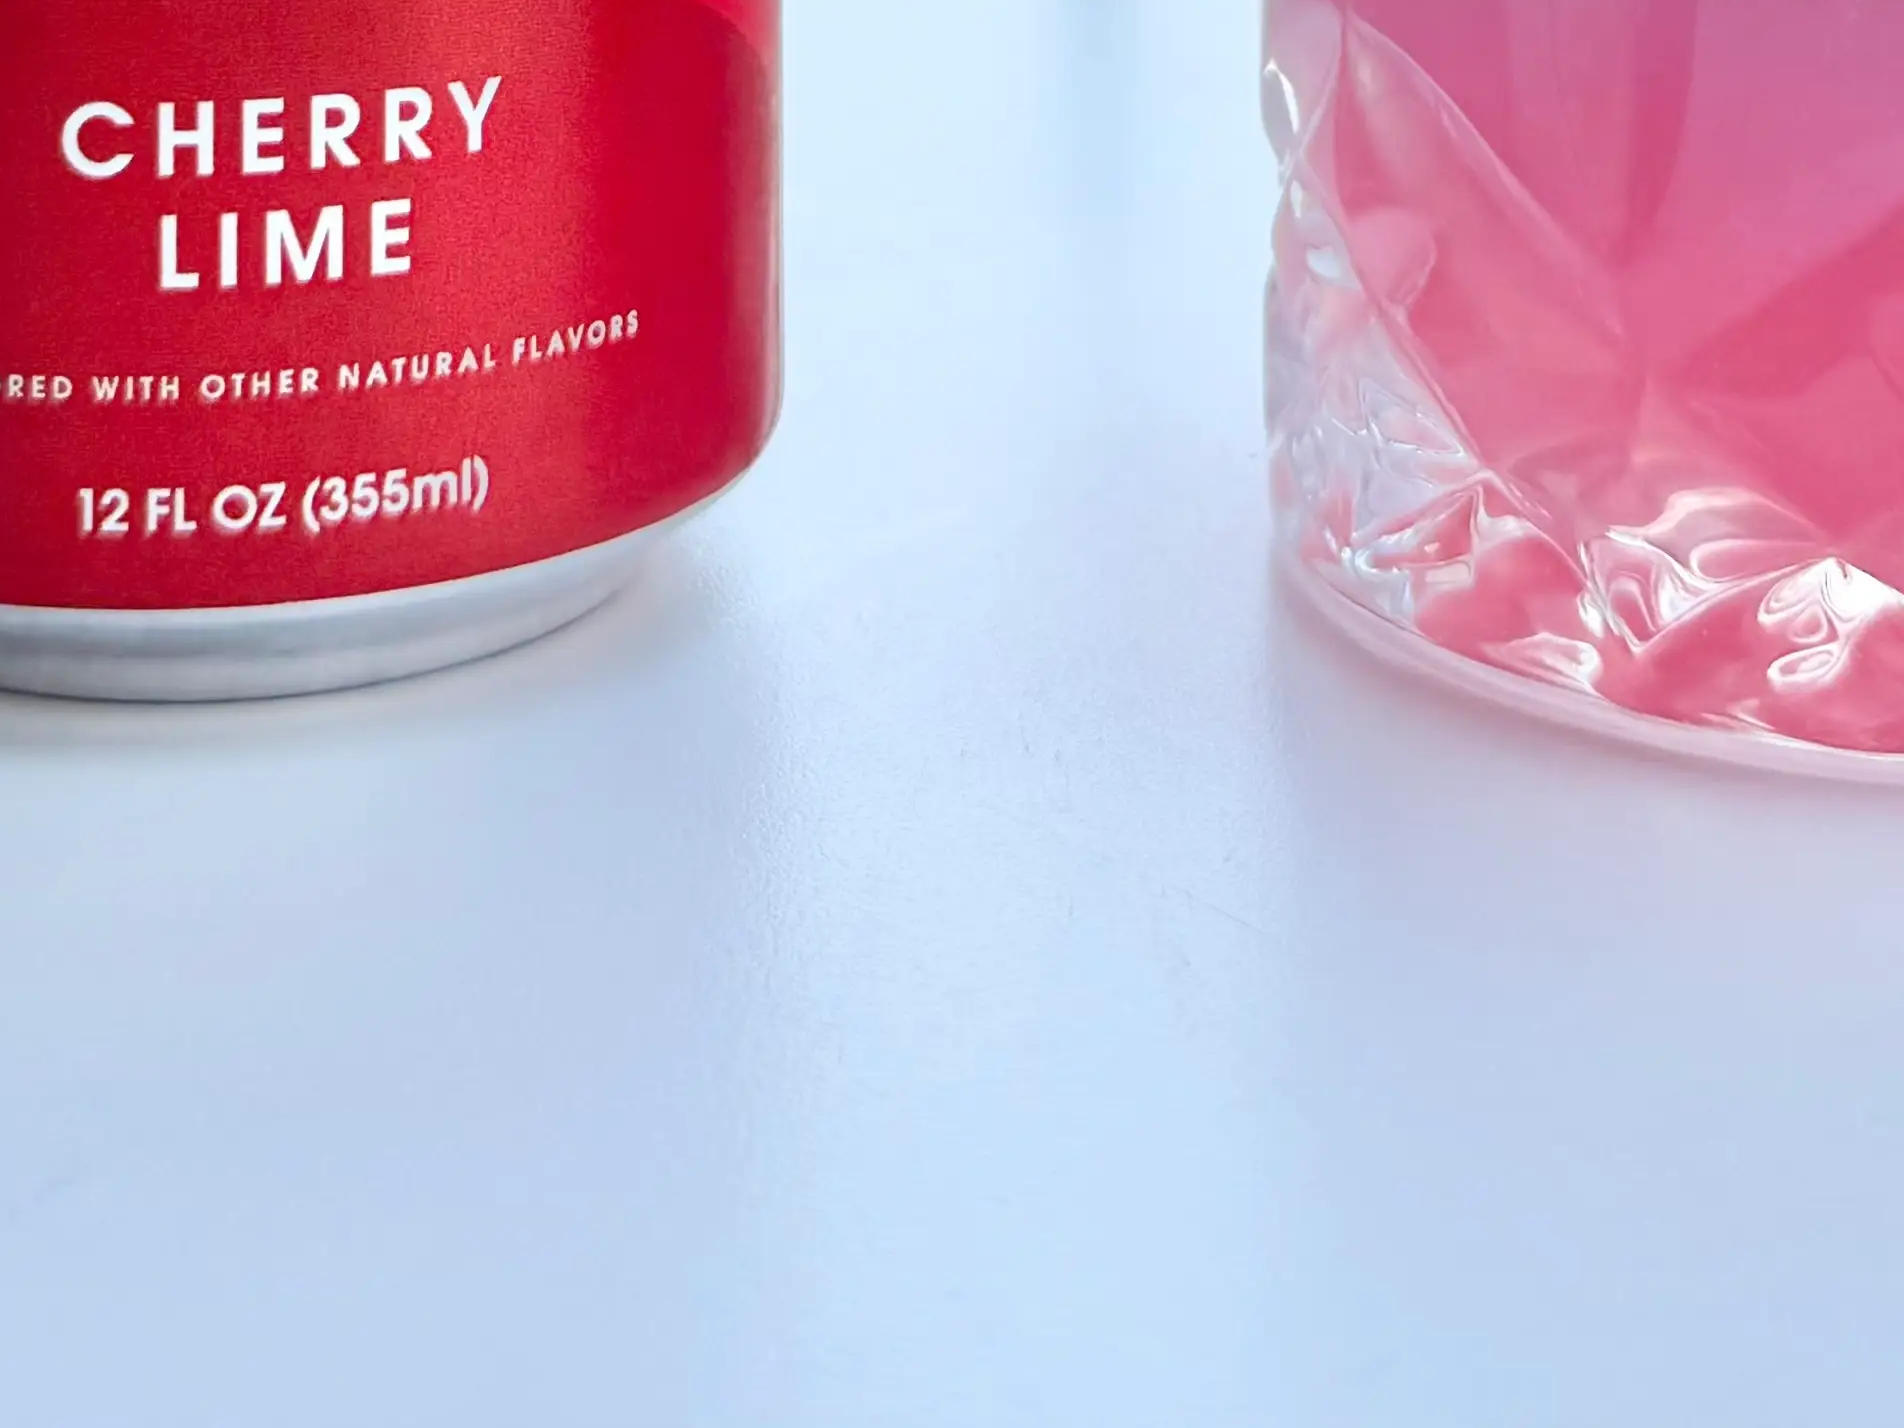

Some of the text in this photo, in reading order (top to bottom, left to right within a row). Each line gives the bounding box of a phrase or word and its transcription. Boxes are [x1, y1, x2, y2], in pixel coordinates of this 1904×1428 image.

[61, 76, 502, 180] CHERRY
[158, 198, 413, 291] LIME
[91, 374, 182, 403] WITH
[199, 367, 320, 403] OTHER
[337, 343, 497, 391] NATURAL
[511, 308, 640, 366] FLAVORS
[78, 454, 490, 536] 12 FL OZ (355ml)
